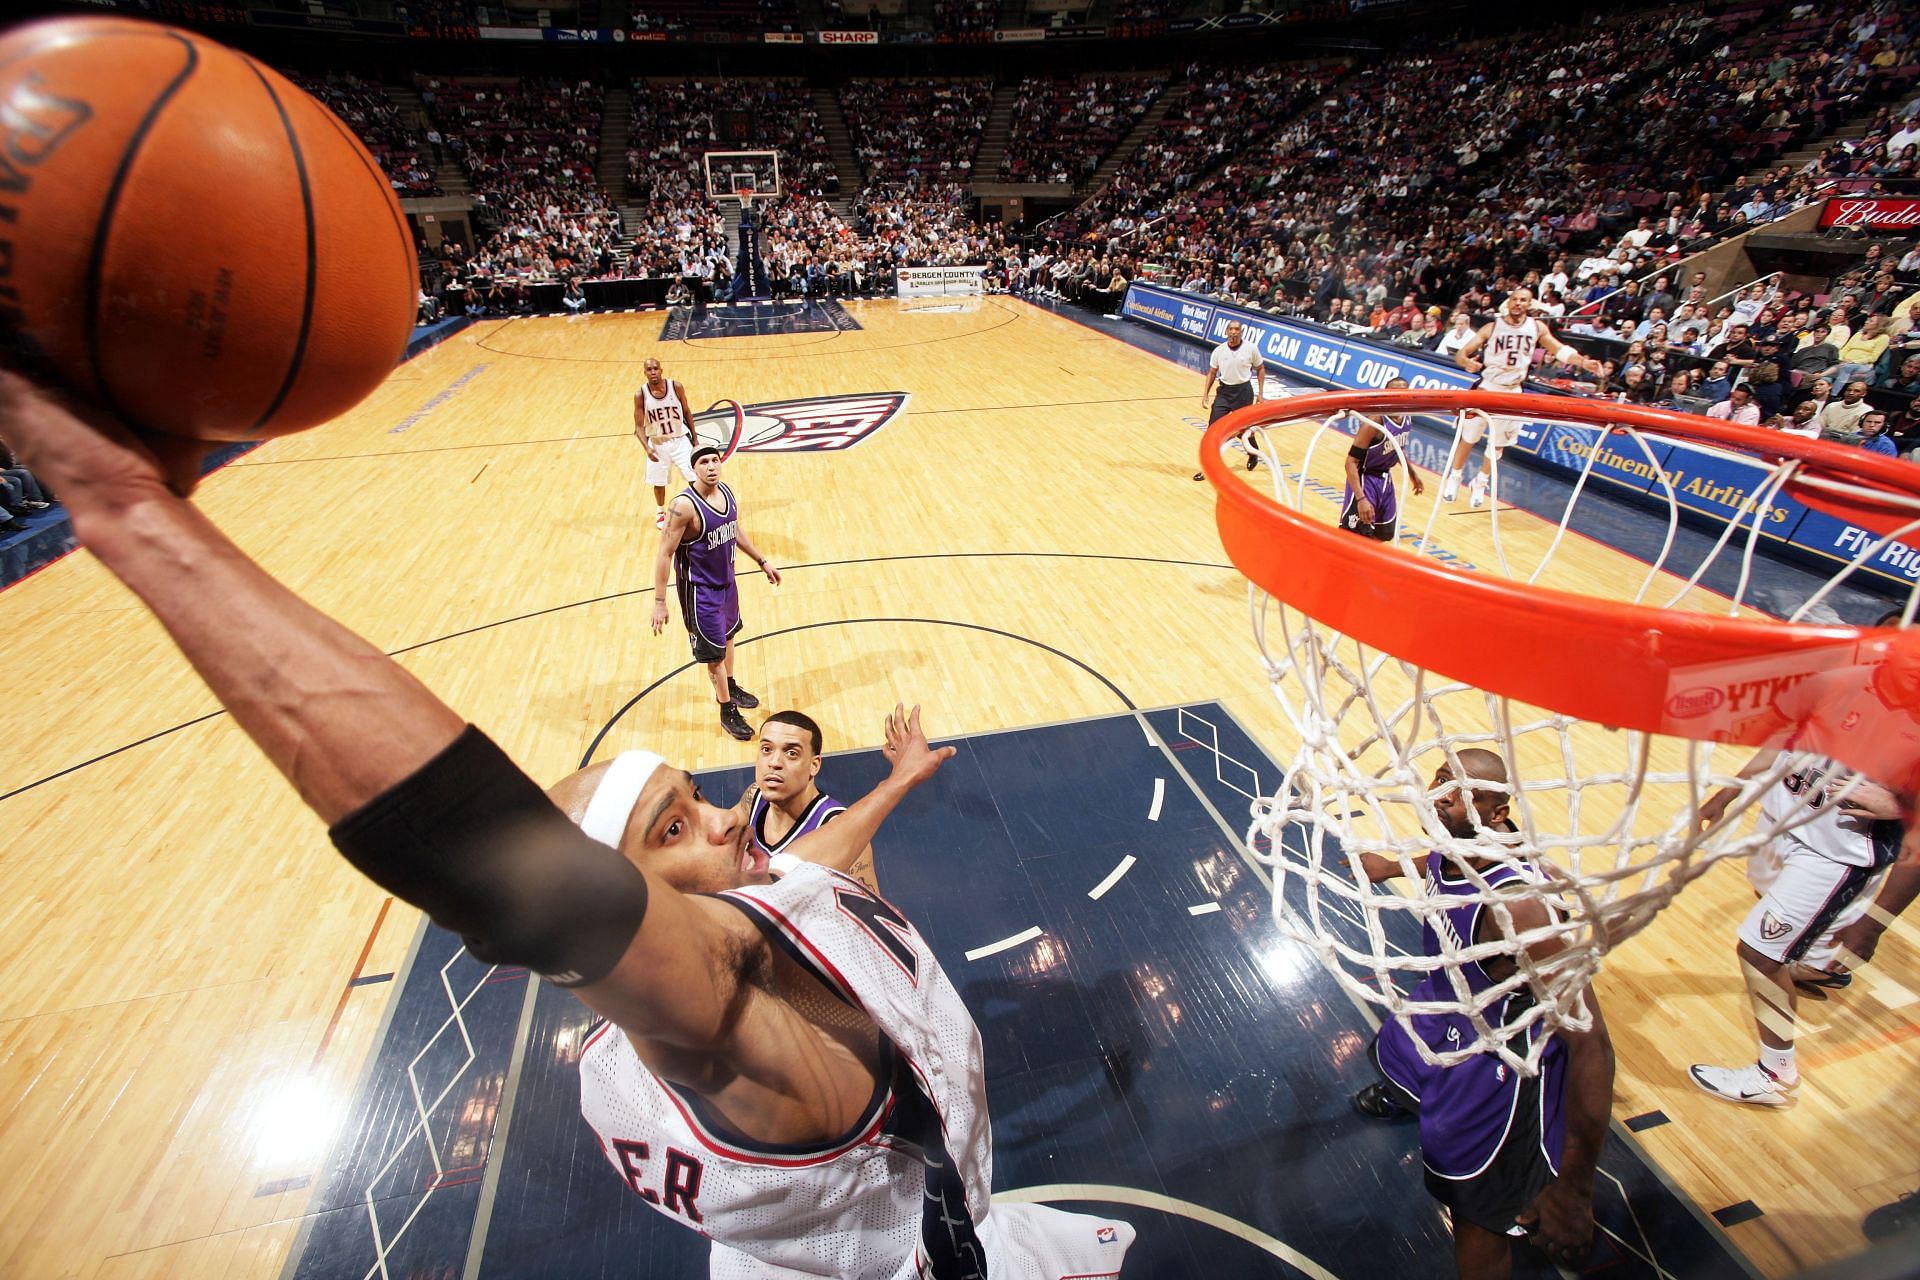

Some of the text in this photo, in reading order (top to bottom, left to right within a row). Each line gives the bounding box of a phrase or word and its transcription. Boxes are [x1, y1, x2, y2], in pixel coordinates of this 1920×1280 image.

[823, 32, 874, 43] SHARP
[912, 271, 942, 279] BERGEN
[1126, 300, 1175, 322] Continental Airlines
[1267, 332, 1302, 361] CAN
[1304, 343, 1352, 377] BEAT
[1494, 335, 1533, 356] NETS
[1506, 350, 1519, 366] 5
[647, 406, 681, 424] NETS
[660, 421, 675, 435] 11
[1556, 434, 1790, 523] Continental Airlines
[1833, 526, 1878, 560] Fly
[606, 1136, 705, 1226] ER
